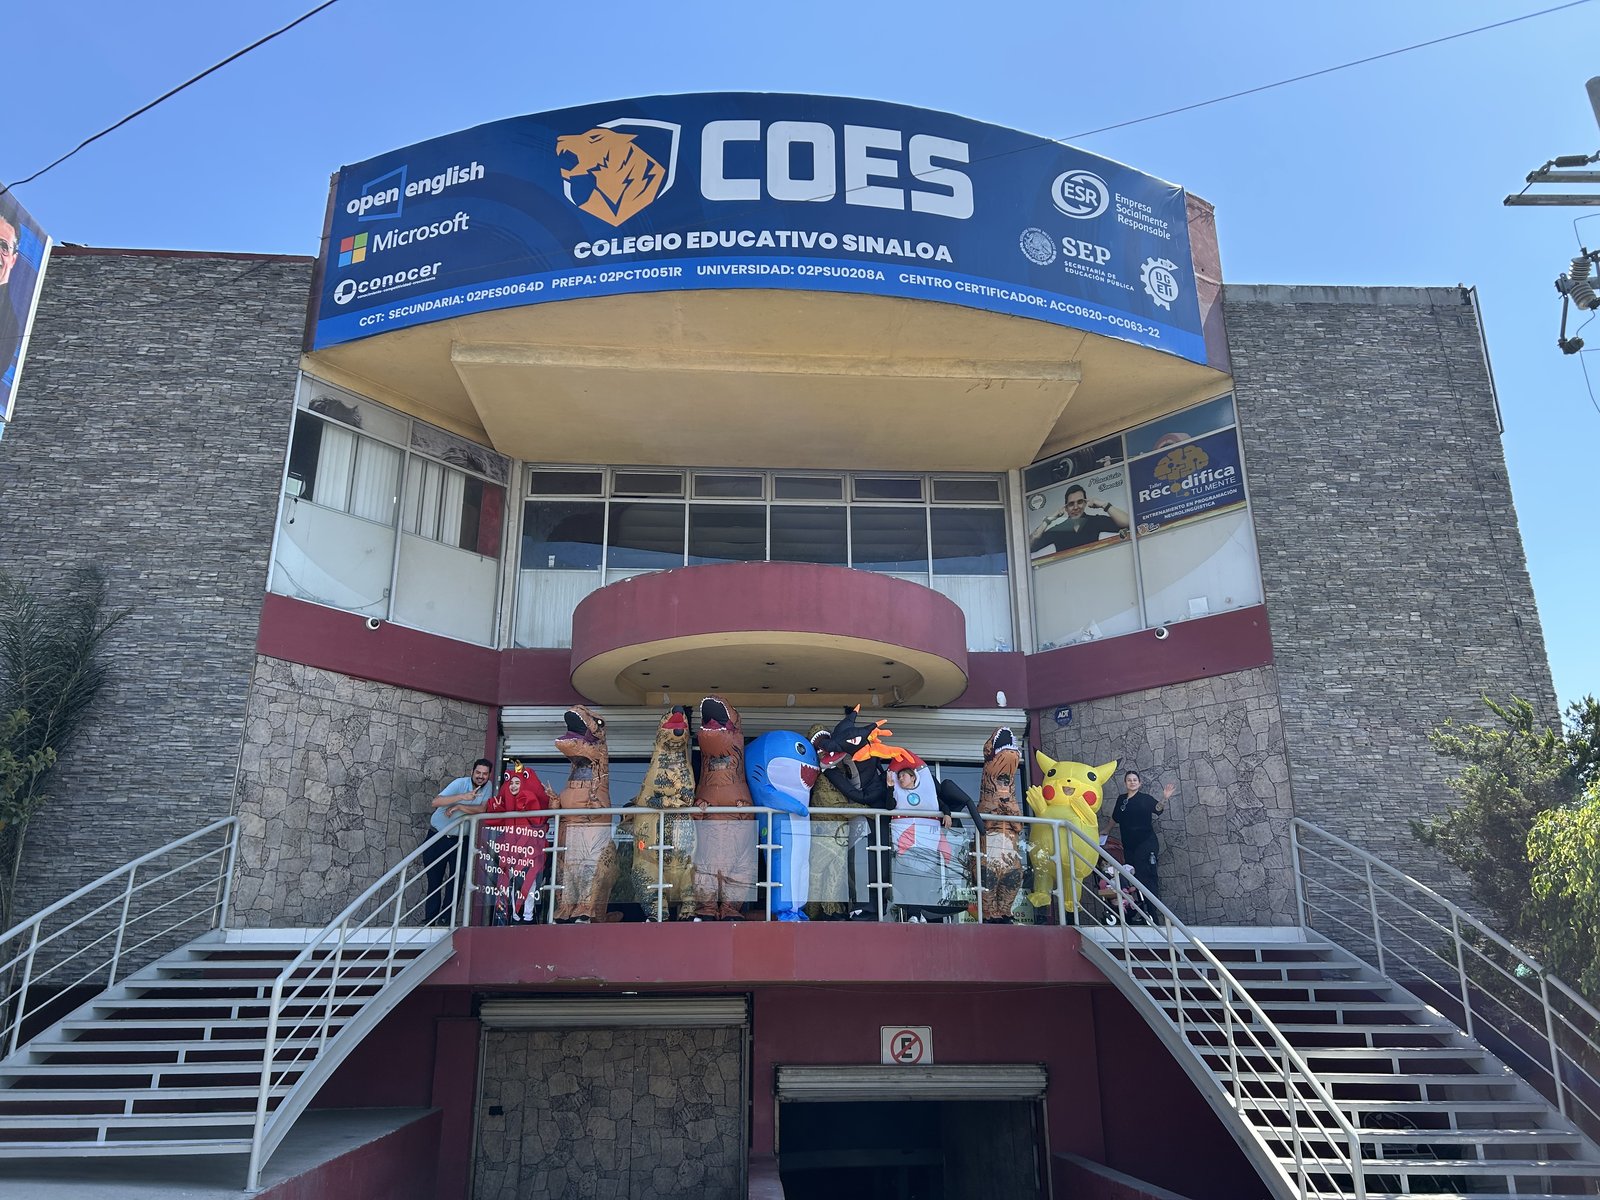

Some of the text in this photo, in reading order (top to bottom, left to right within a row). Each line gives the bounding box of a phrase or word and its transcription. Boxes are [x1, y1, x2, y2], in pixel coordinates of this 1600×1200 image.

[700, 119, 975, 220] COES
[346, 161, 485, 216] open english
[1064, 182, 1098, 207] ESR
[1115, 192, 1152, 214] Empresa
[1115, 203, 1168, 229] Socialmente
[372, 211, 470, 253] Microsoft
[1117, 213, 1171, 240] Responsable
[573, 230, 953, 263] COLEGIO EDUCATIVO SINALOA
[1062, 236, 1111, 266] SEP
[358, 261, 442, 293] conocer
[1064, 260, 1116, 280] SECRETARÍA DE
[1065, 267, 1135, 292] EDUCACIÓN PÚBLICA
[358, 312, 385, 327] CCT:
[388, 294, 465, 320] SECUNDARIA:
[466, 280, 544, 302] 02PES0064D
[551, 273, 597, 289] PREPA:
[599, 265, 683, 283] 02PCT0051R
[696, 263, 795, 276] UNIVERSIDAD:
[797, 264, 885, 282] 02PSU0208A
[898, 272, 952, 289] CENTRO
[954, 280, 1048, 308] CERTIFICADOR:
[1190, 475, 1236, 495] TU MENTE
[1142, 504, 1185, 520] ENTRENAMIENTO
